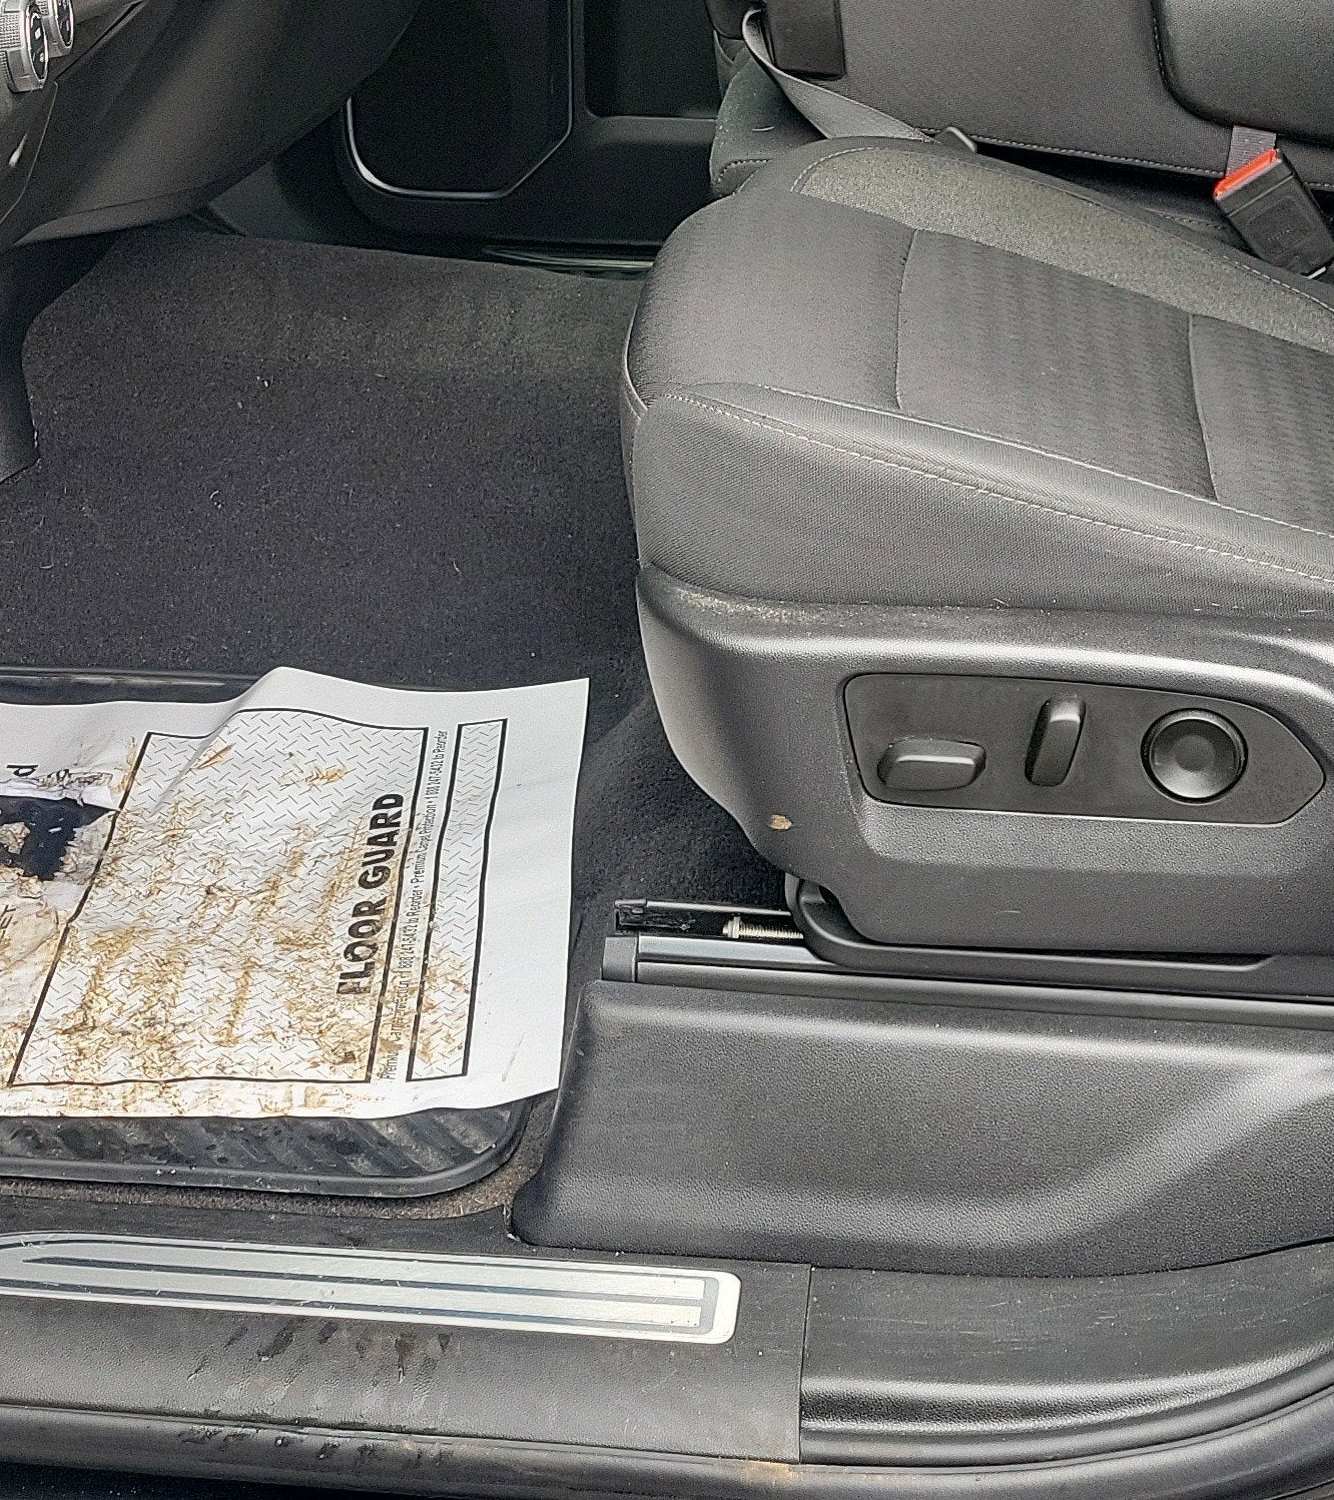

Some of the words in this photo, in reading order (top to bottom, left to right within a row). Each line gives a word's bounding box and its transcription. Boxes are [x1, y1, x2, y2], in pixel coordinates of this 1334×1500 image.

[433, 730, 447, 753] Reorder
[358, 793, 404, 889] GUARD
[411, 853, 427, 883] Premium
[406, 889, 424, 916] Reorder
[336, 895, 386, 995] FLOOR
